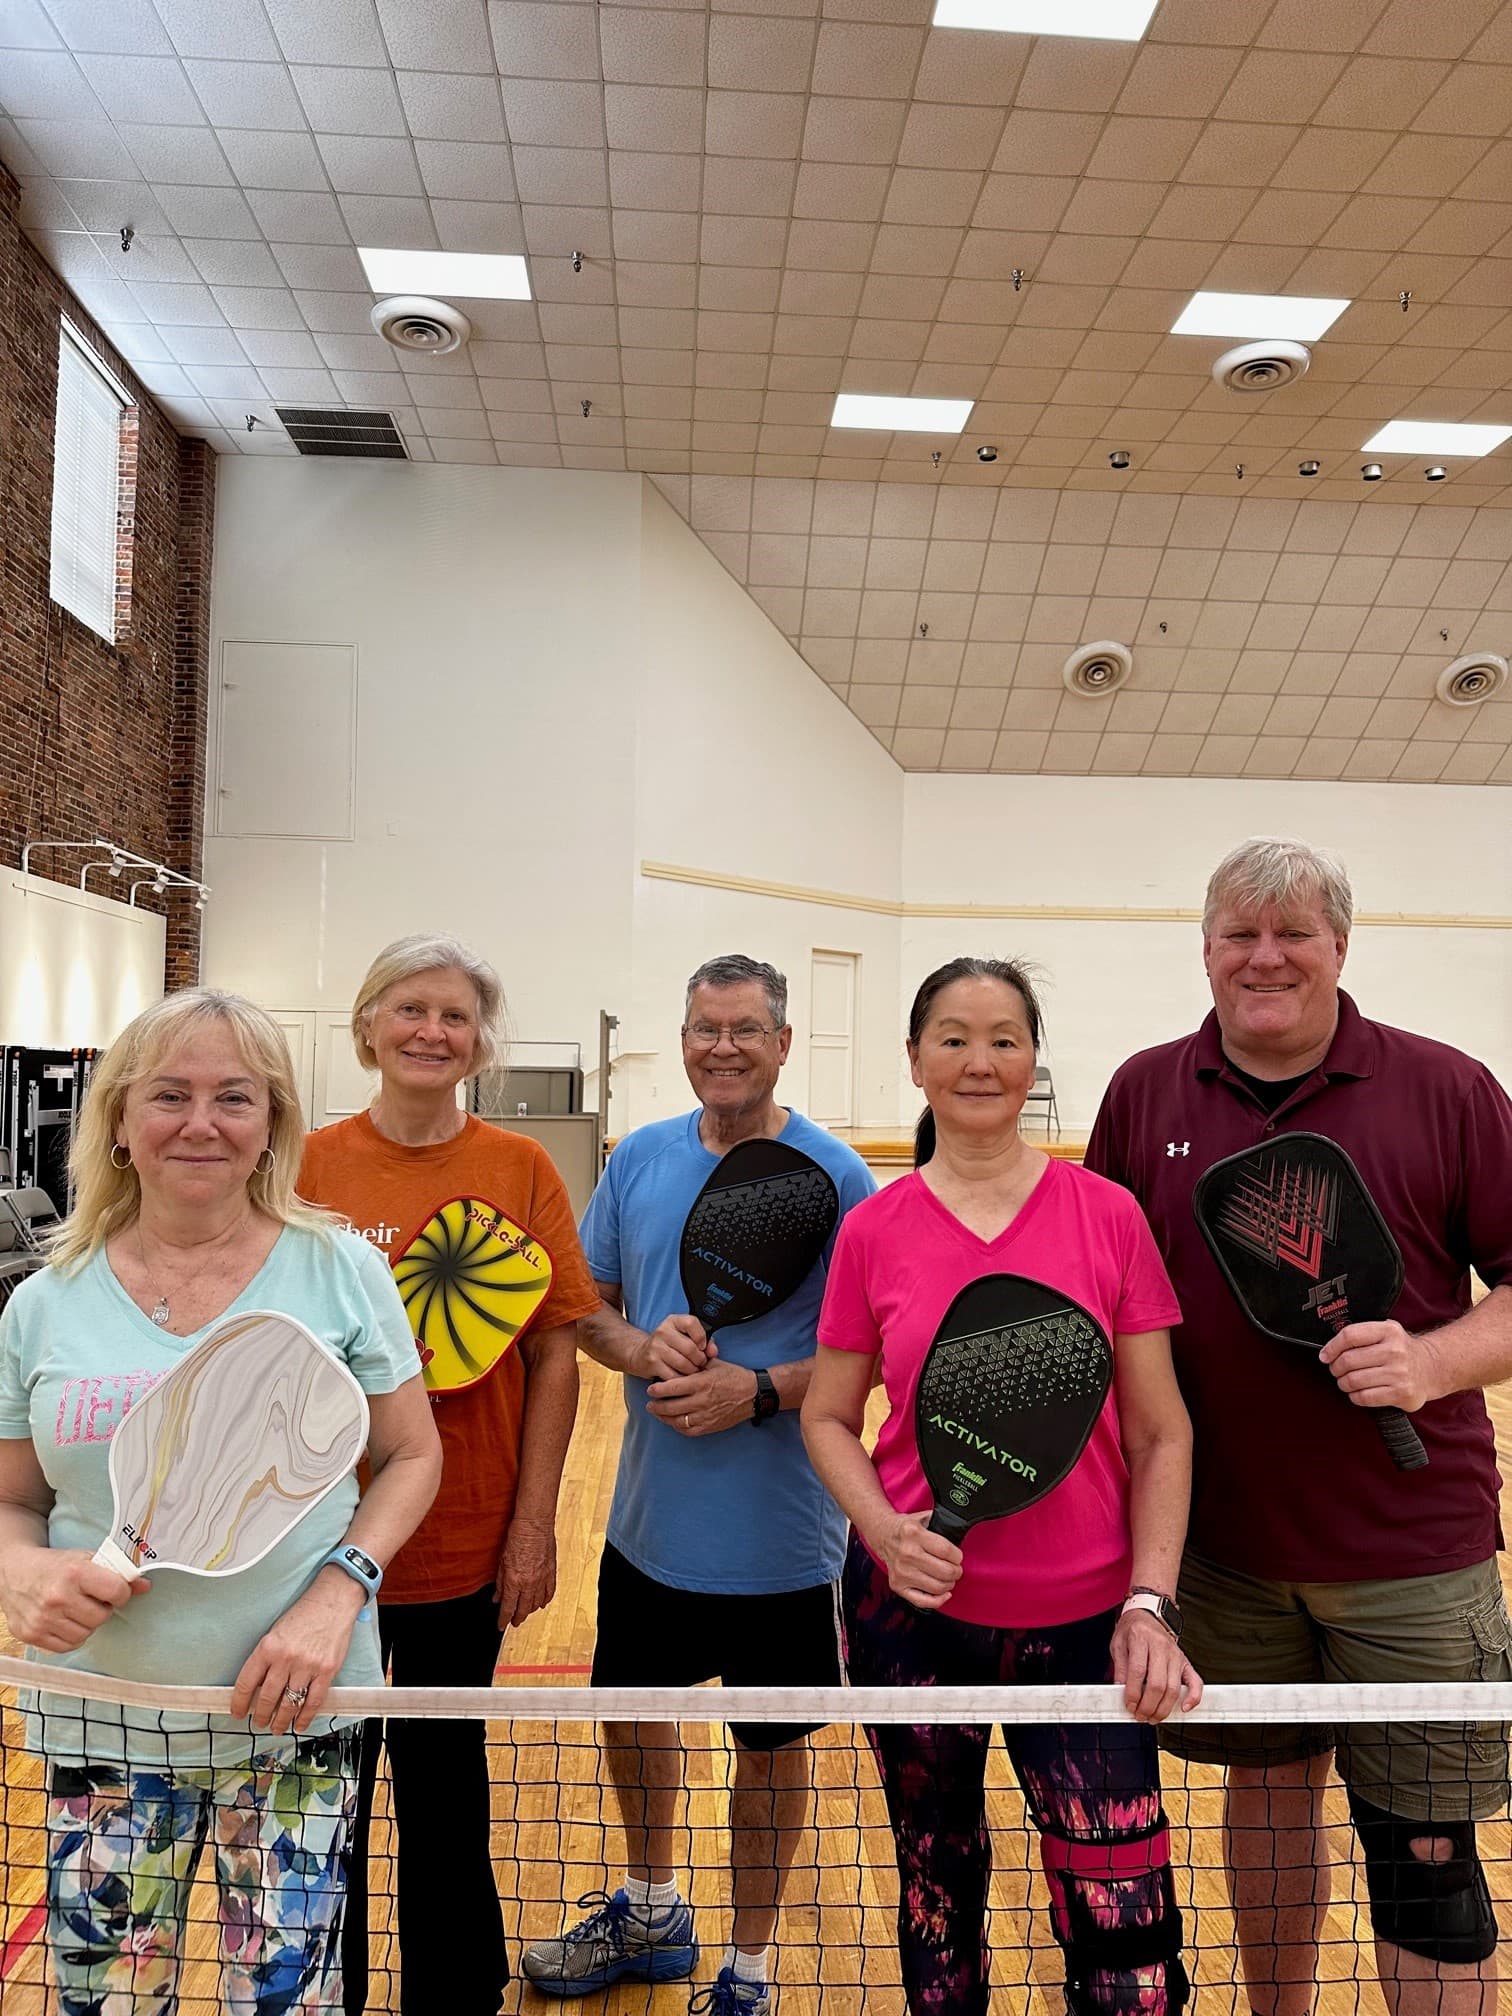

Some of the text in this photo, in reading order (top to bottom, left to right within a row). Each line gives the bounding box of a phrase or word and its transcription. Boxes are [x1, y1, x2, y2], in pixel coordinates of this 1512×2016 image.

[690, 1246, 774, 1297] ACTIVATOR
[1301, 1273, 1349, 1312] JET
[929, 1413, 1037, 1482] ACTIVATOR
